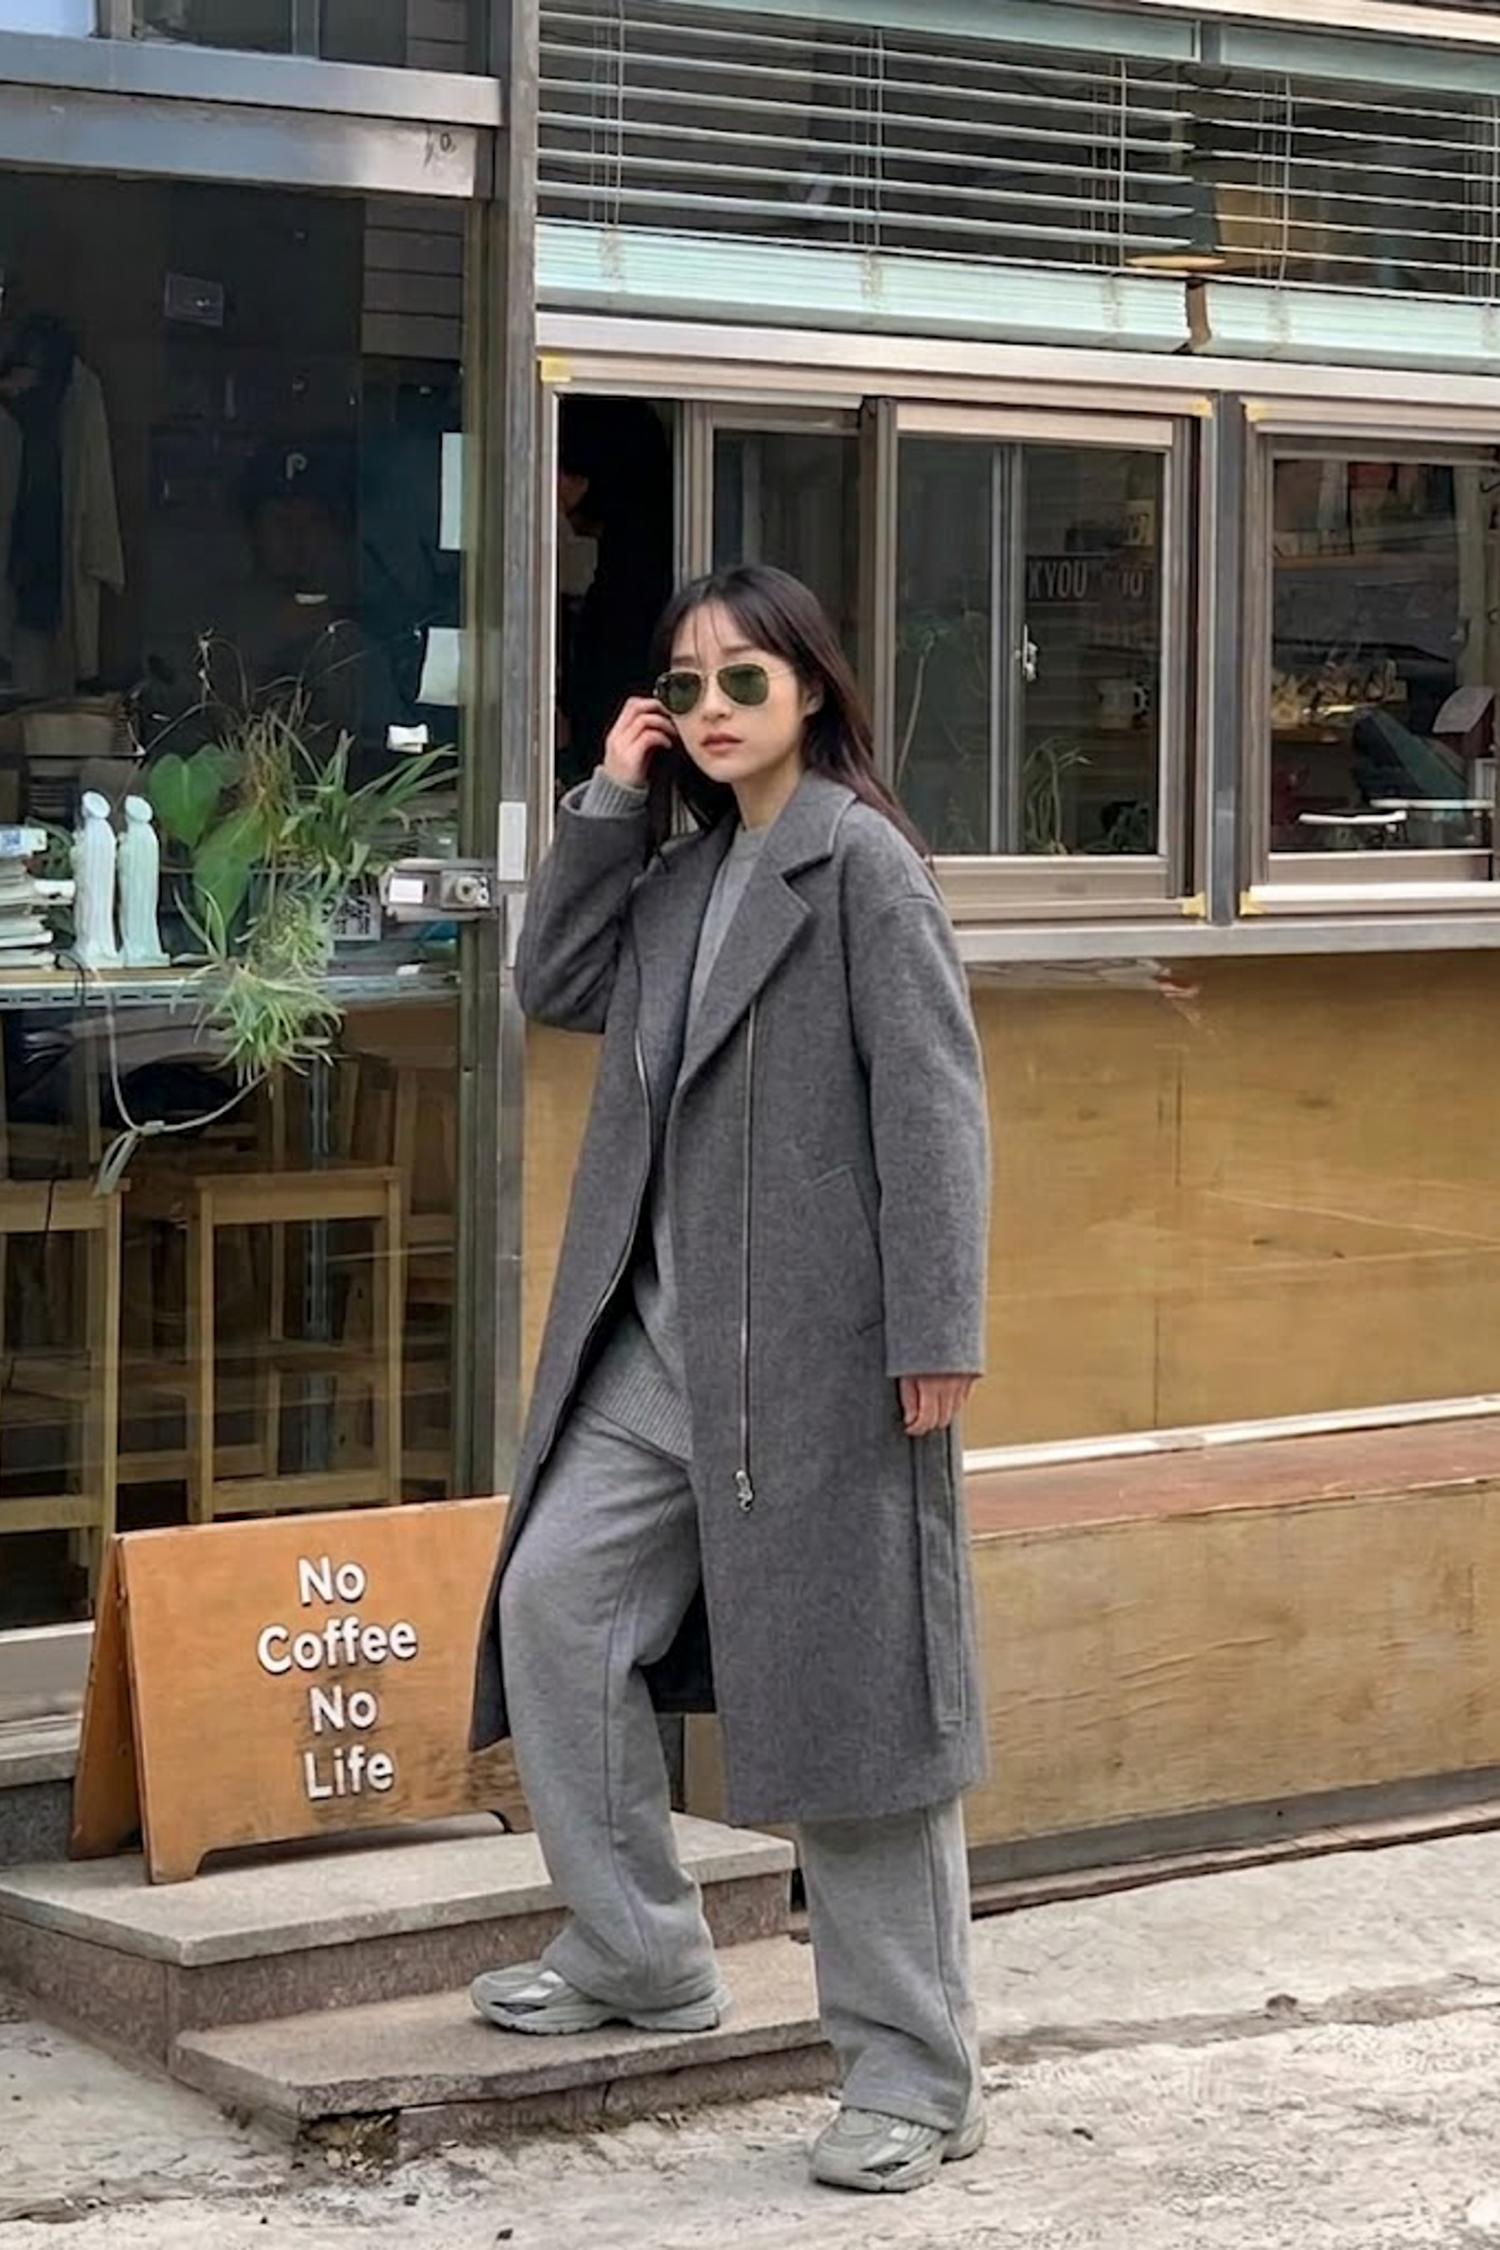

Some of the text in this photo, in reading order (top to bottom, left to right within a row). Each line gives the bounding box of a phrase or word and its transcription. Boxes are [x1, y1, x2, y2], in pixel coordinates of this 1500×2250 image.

[299, 1556, 367, 1605] No
[258, 1616, 418, 1673] Coffee
[310, 1685, 378, 1733] No
[304, 1745, 395, 1799] Life
